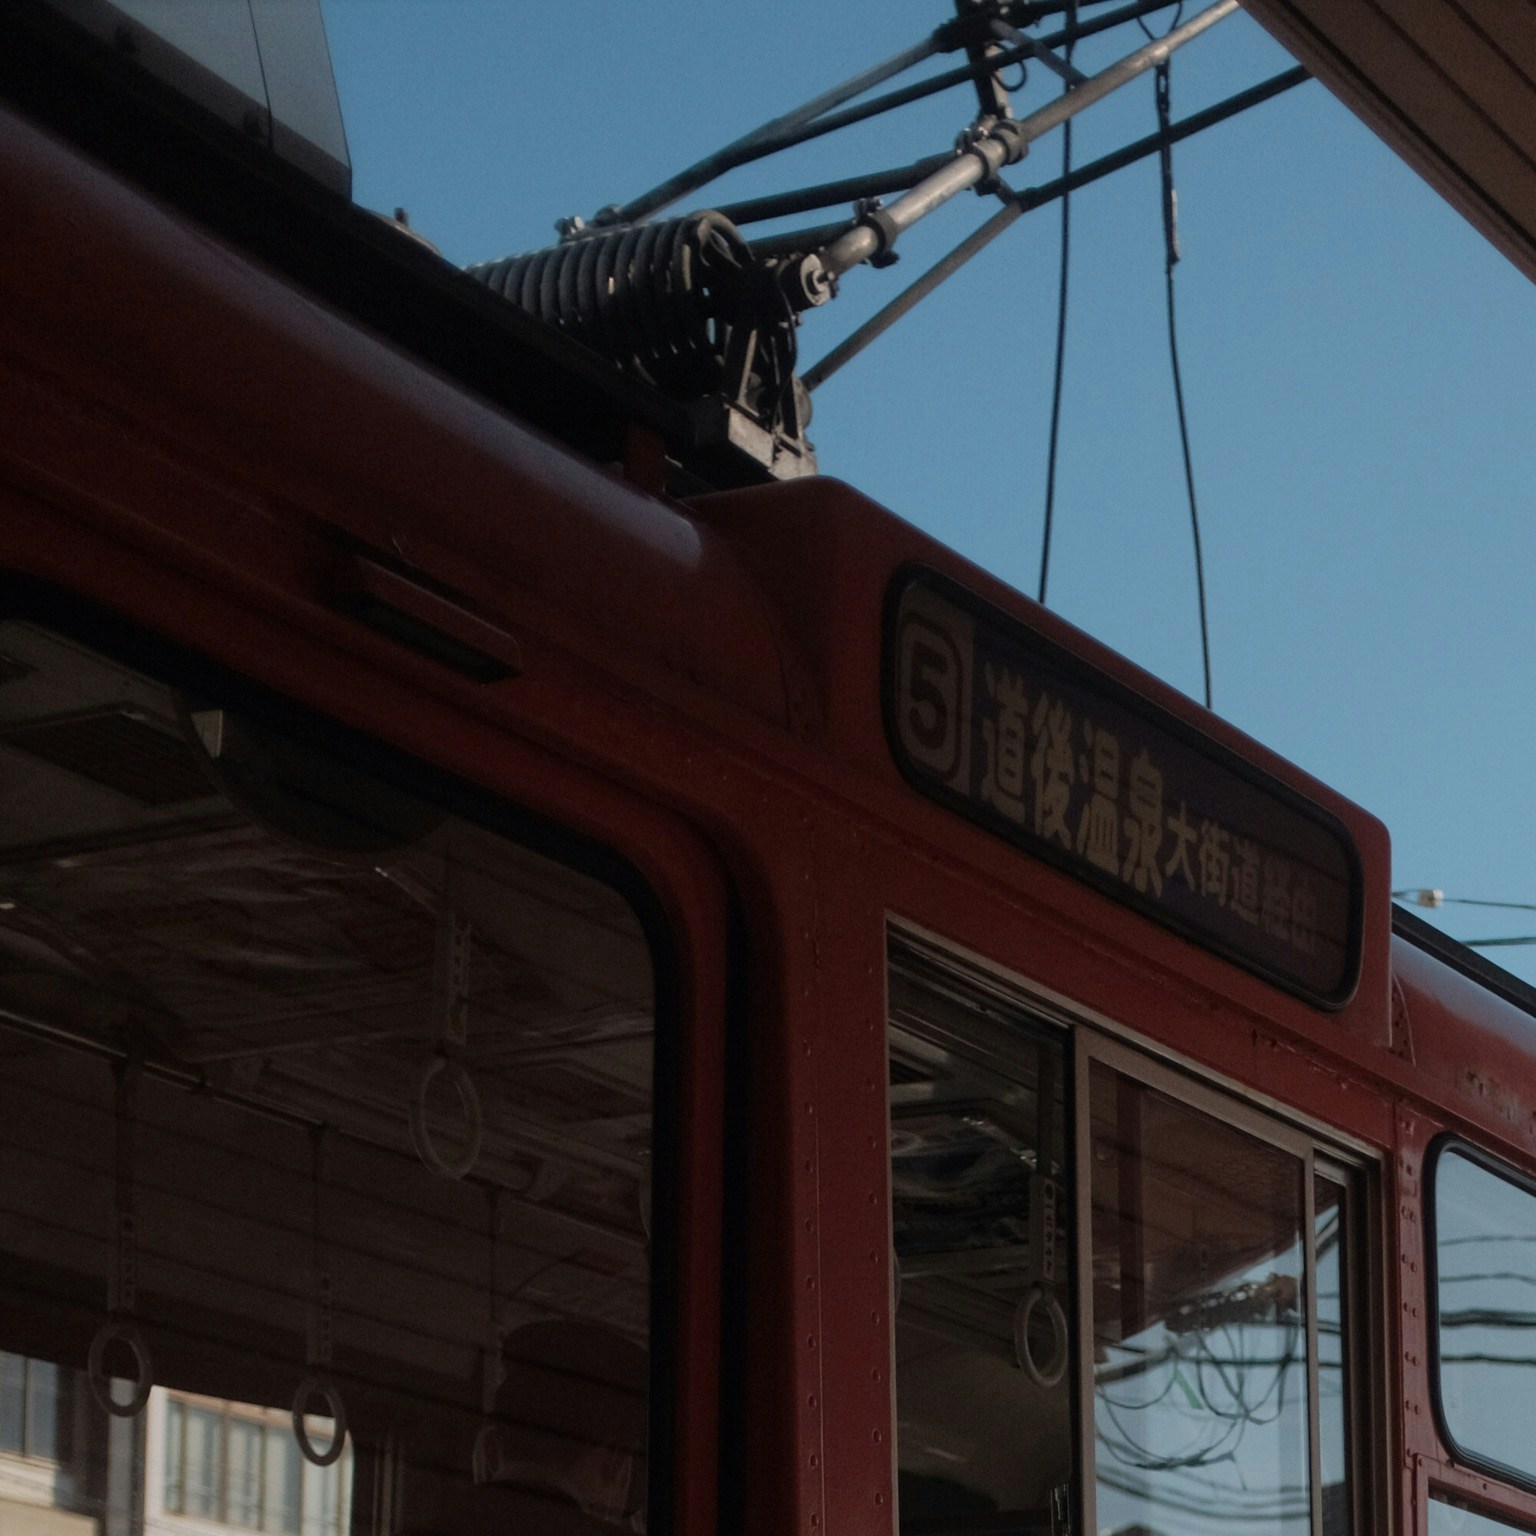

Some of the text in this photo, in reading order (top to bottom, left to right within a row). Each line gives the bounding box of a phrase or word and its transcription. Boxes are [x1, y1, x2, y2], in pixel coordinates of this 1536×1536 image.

[909, 640, 949, 750] 5
[981, 661, 1164, 899] 道後温泉
